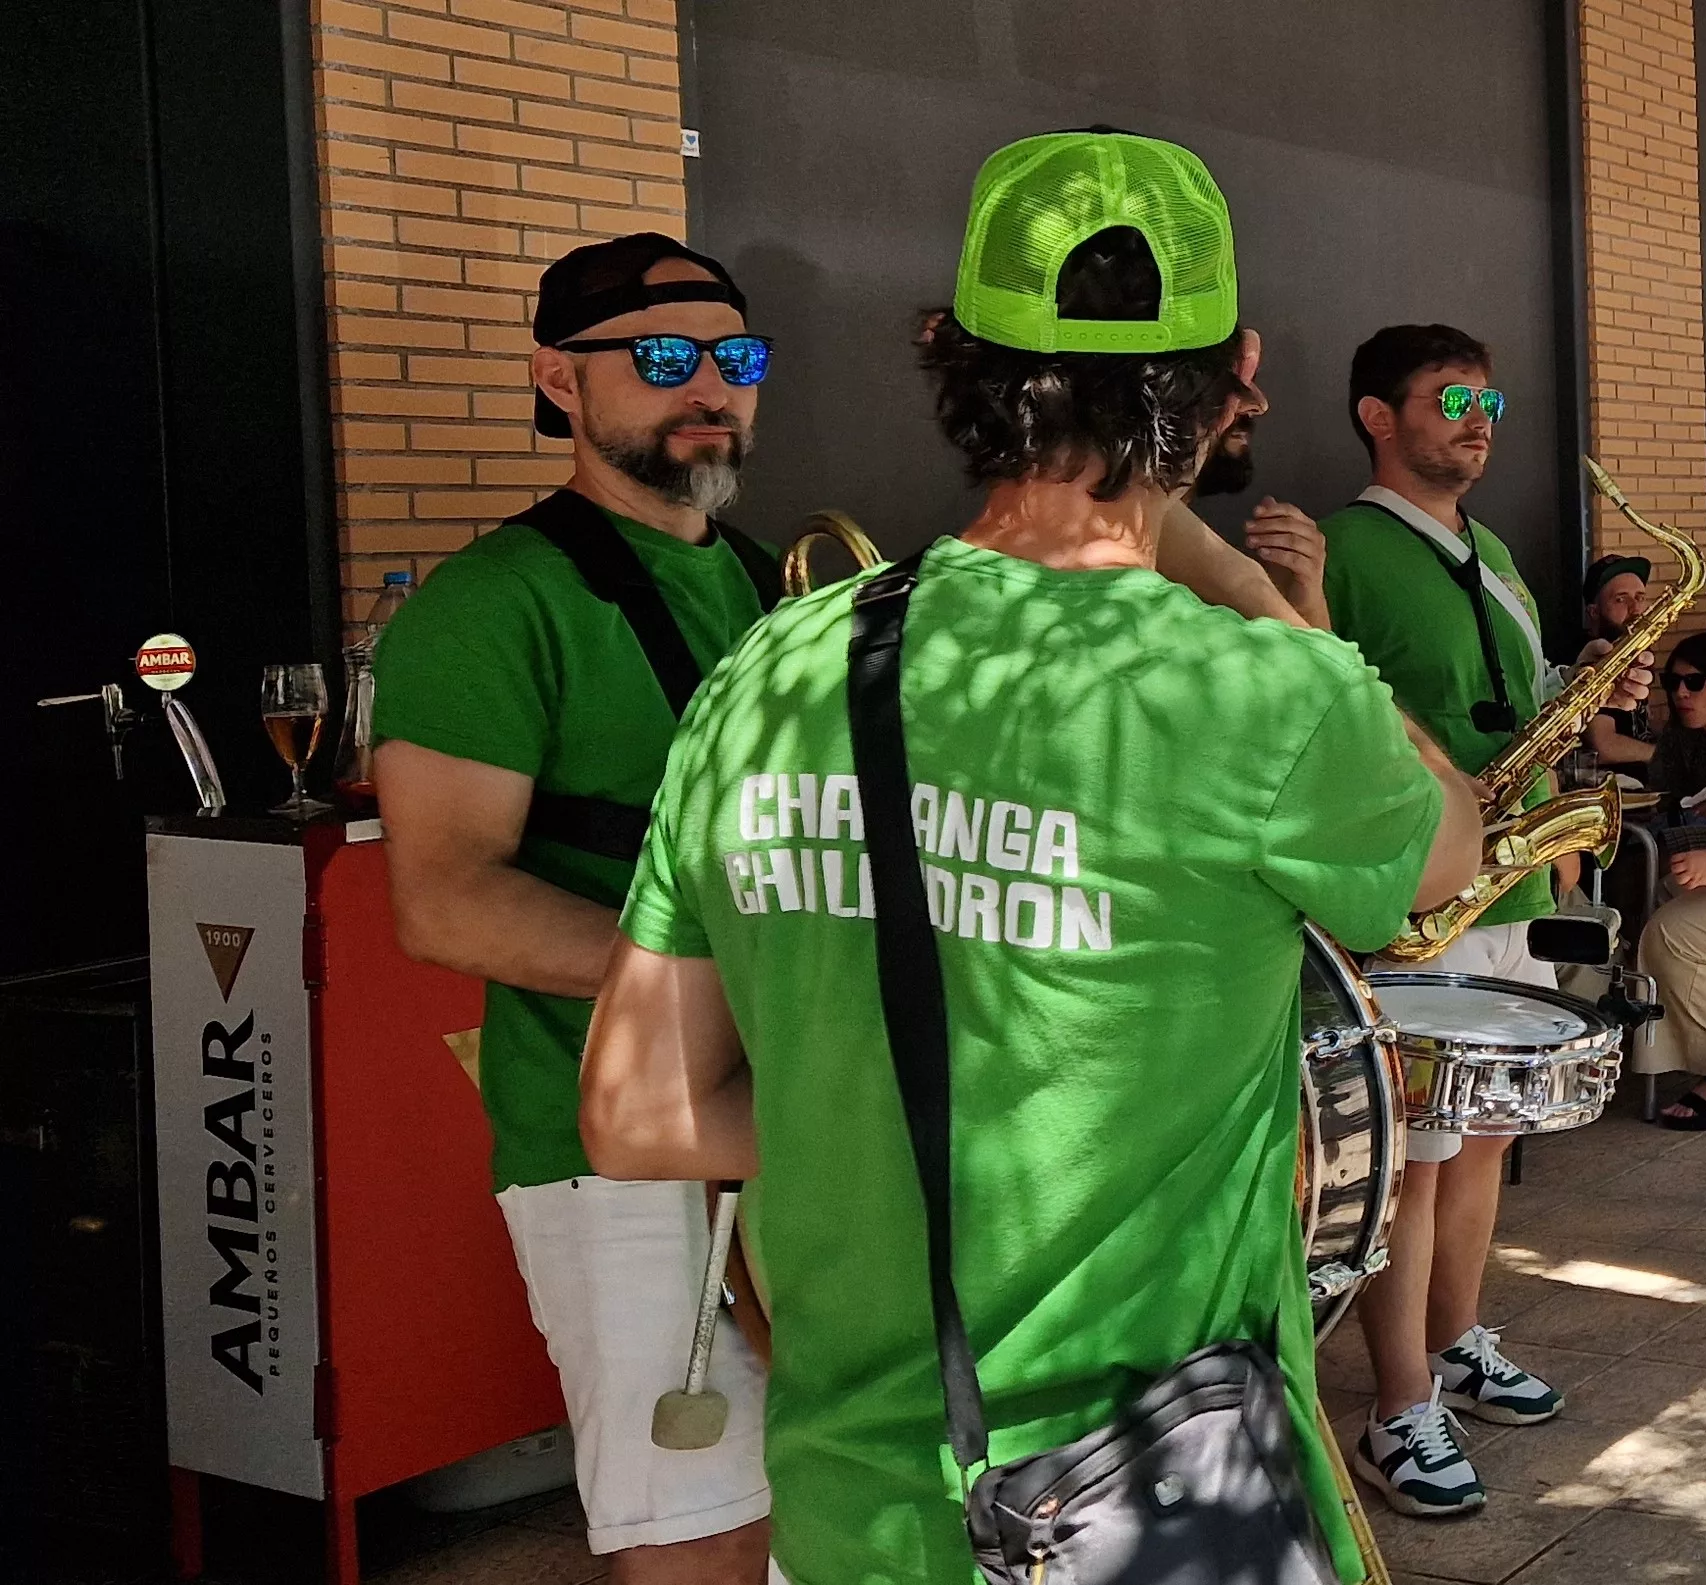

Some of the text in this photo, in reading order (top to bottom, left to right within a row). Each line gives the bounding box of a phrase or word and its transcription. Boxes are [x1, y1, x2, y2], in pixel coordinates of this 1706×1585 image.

[139, 652, 192, 667] AMBAR
[740, 774, 1079, 878] CHAANGA
[206, 930, 241, 947] 1900
[724, 849, 1112, 951] CHILIDRON
[202, 1009, 263, 1397] AMBAR
[261, 1032, 281, 1377] PEQUEÑOS CERVECEROS
